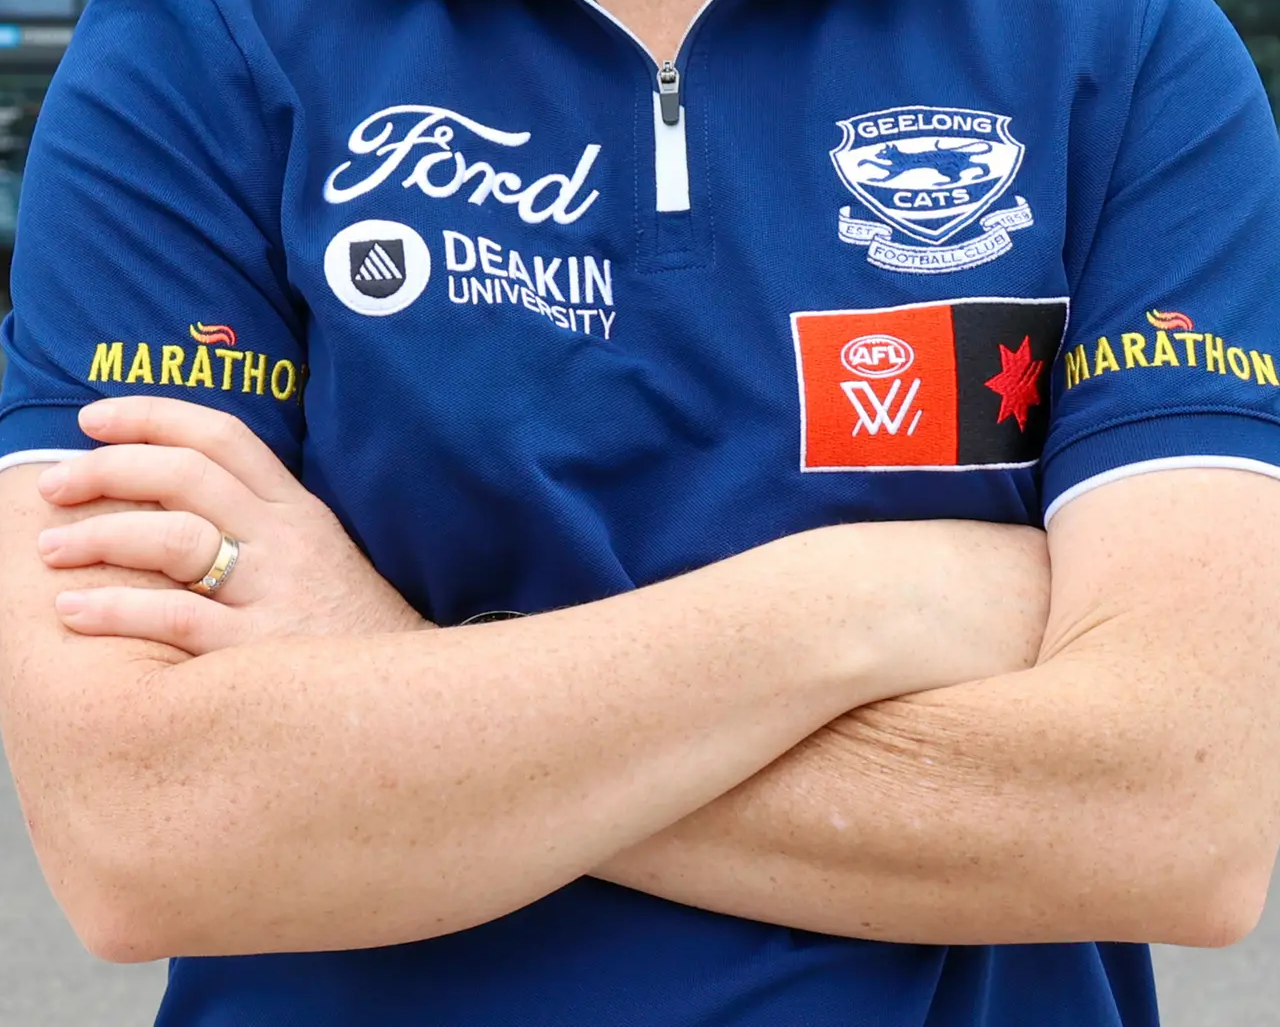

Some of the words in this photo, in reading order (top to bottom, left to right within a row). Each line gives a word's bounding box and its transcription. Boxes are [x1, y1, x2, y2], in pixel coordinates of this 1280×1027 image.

[856, 113, 993, 139] GEELONG
[322, 103, 602, 225] Ford
[892, 188, 970, 208] CATS
[441, 229, 615, 307] DEAKIN
[873, 245, 963, 266] FOOTBALL
[963, 234, 1007, 258] CLUB
[448, 275, 617, 341] UNIVERSITY
[87, 339, 308, 404] MARATHO
[850, 344, 905, 366] AFL
[1063, 329, 1280, 390] MARATHON
